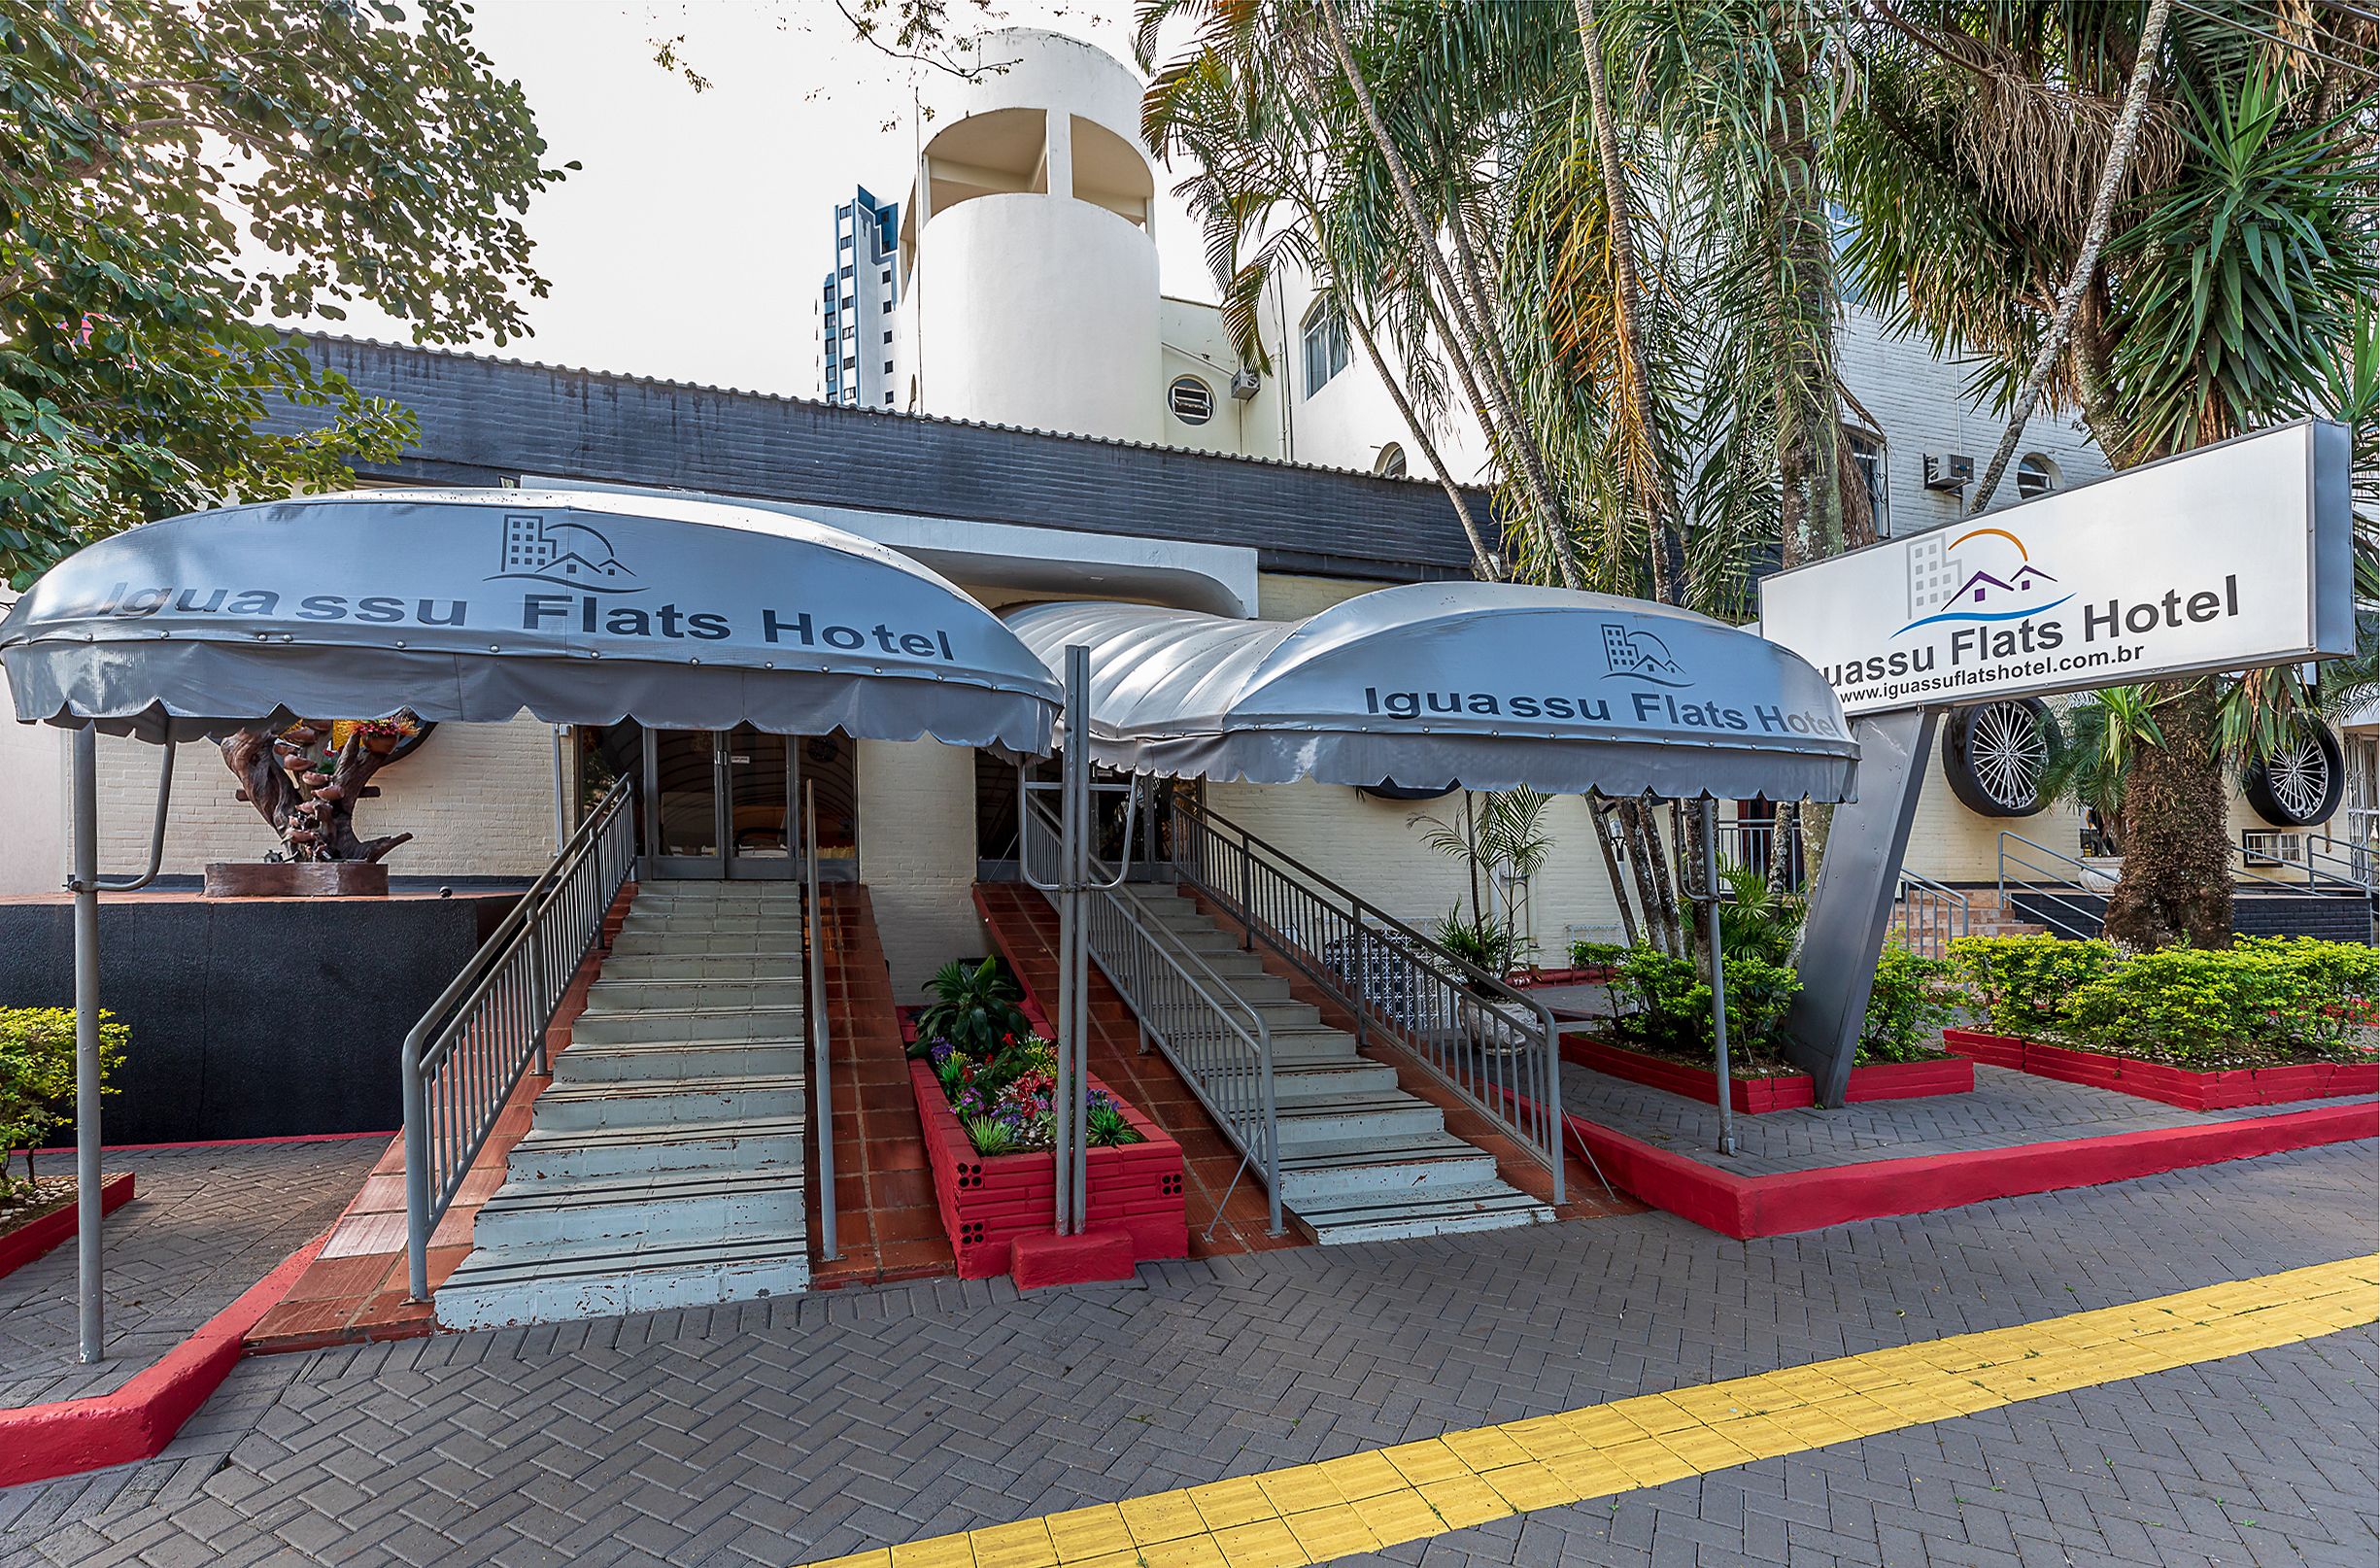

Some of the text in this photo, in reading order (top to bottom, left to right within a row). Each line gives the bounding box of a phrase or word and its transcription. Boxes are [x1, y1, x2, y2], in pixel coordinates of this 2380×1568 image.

[523, 594, 731, 640] Flats
[762, 608, 955, 662] Hotel
[1817, 573, 2239, 688] uassu Flats Hotel
[1840, 644, 2145, 704] www.iguassuflatshotel.com.br
[1364, 687, 1838, 738] Iguassu Flats Hotel
